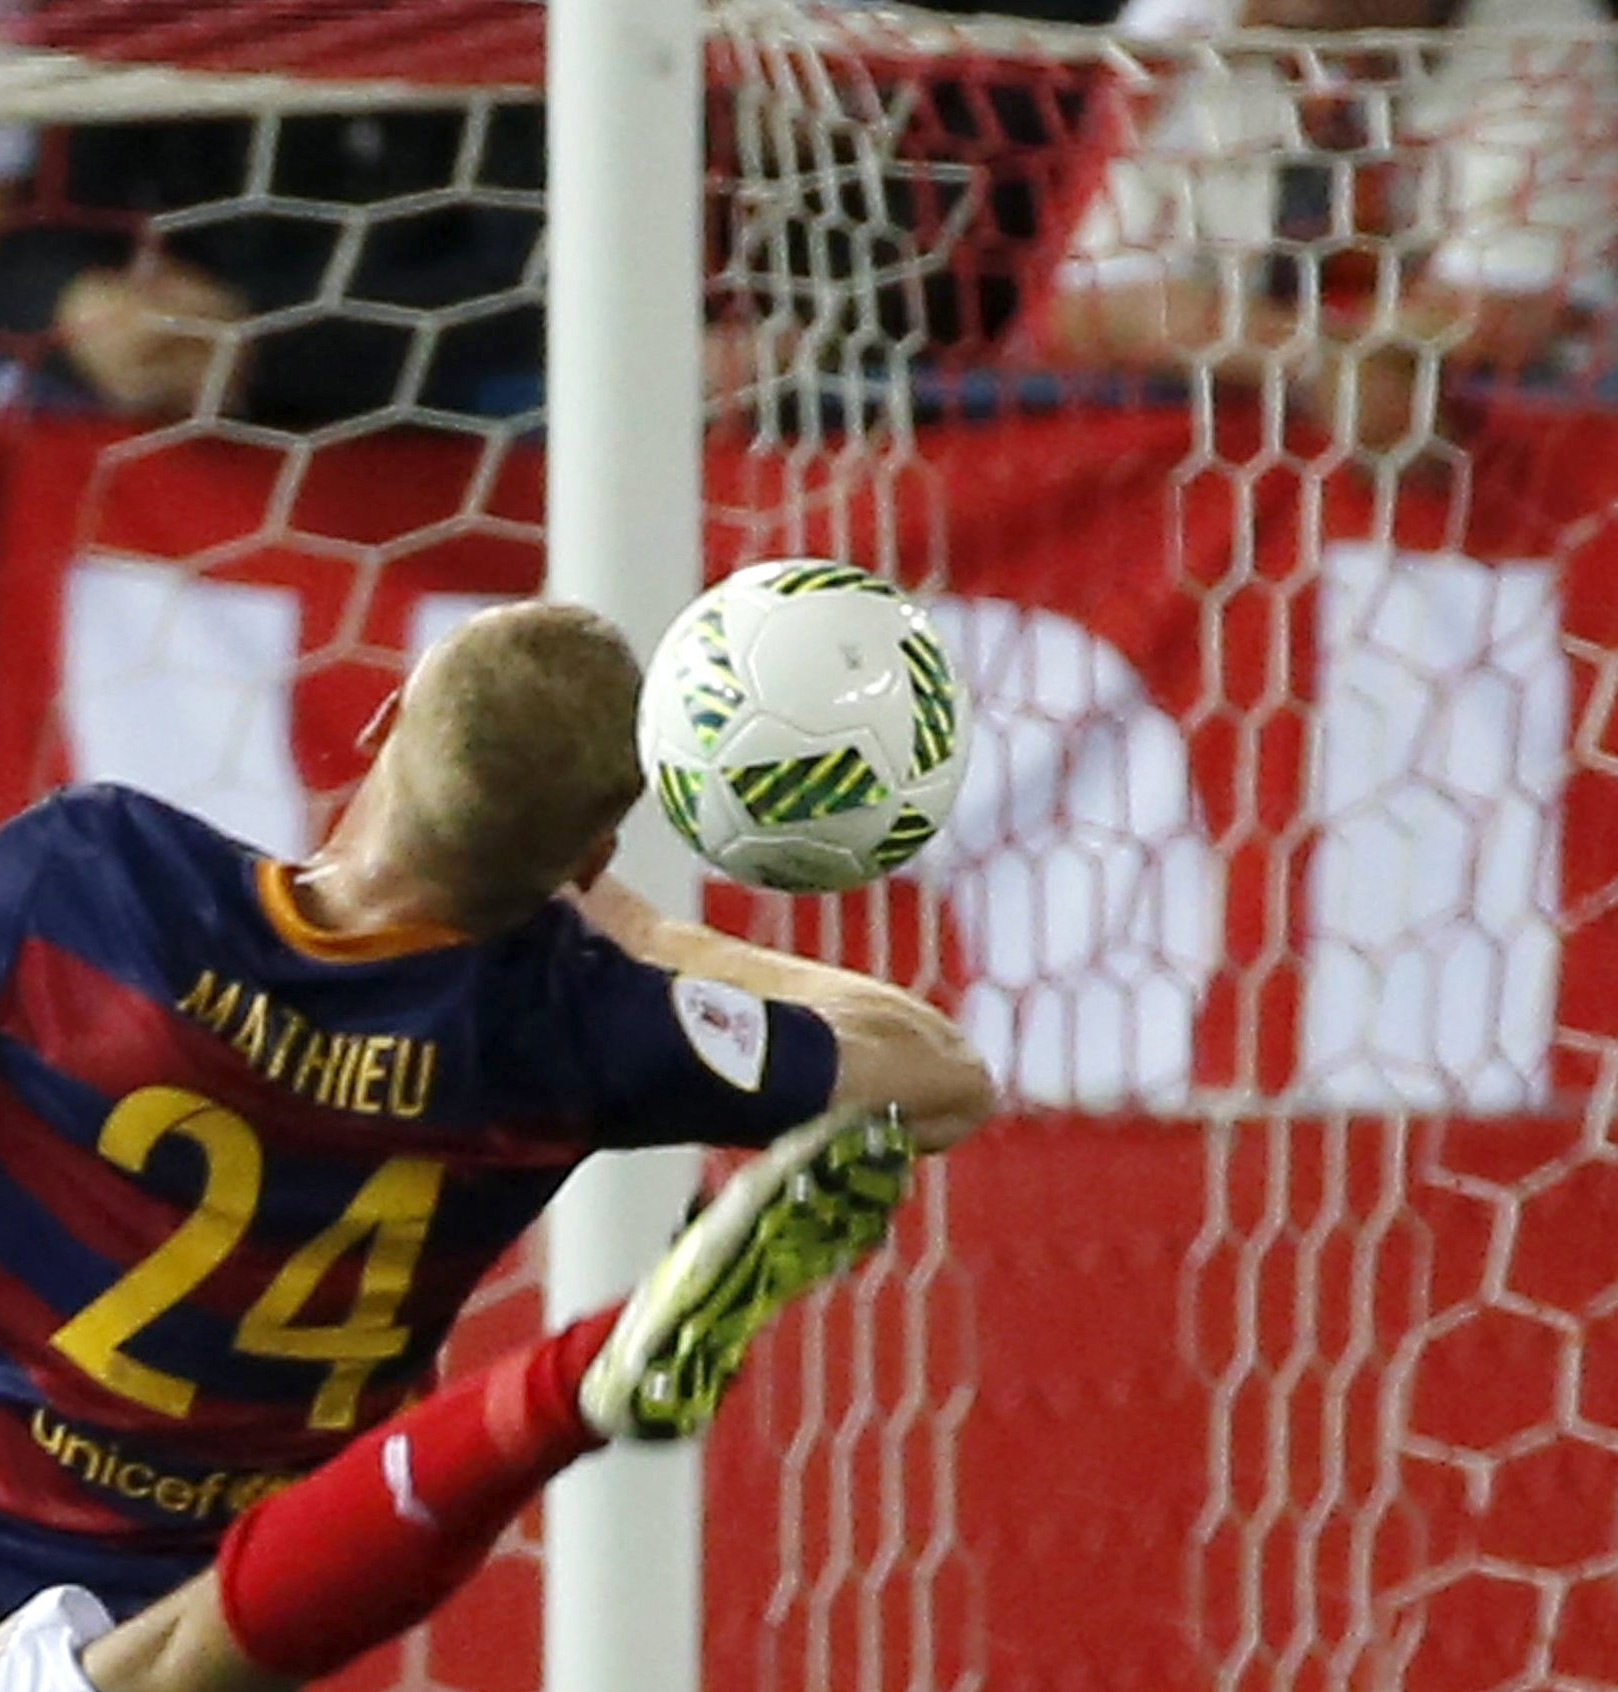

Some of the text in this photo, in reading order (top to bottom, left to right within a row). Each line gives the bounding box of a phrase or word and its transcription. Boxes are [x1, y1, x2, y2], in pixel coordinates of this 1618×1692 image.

[174, 968, 437, 1118] MATHIEU
[49, 1085, 445, 1429] 24
[29, 1406, 229, 1520] unicef
